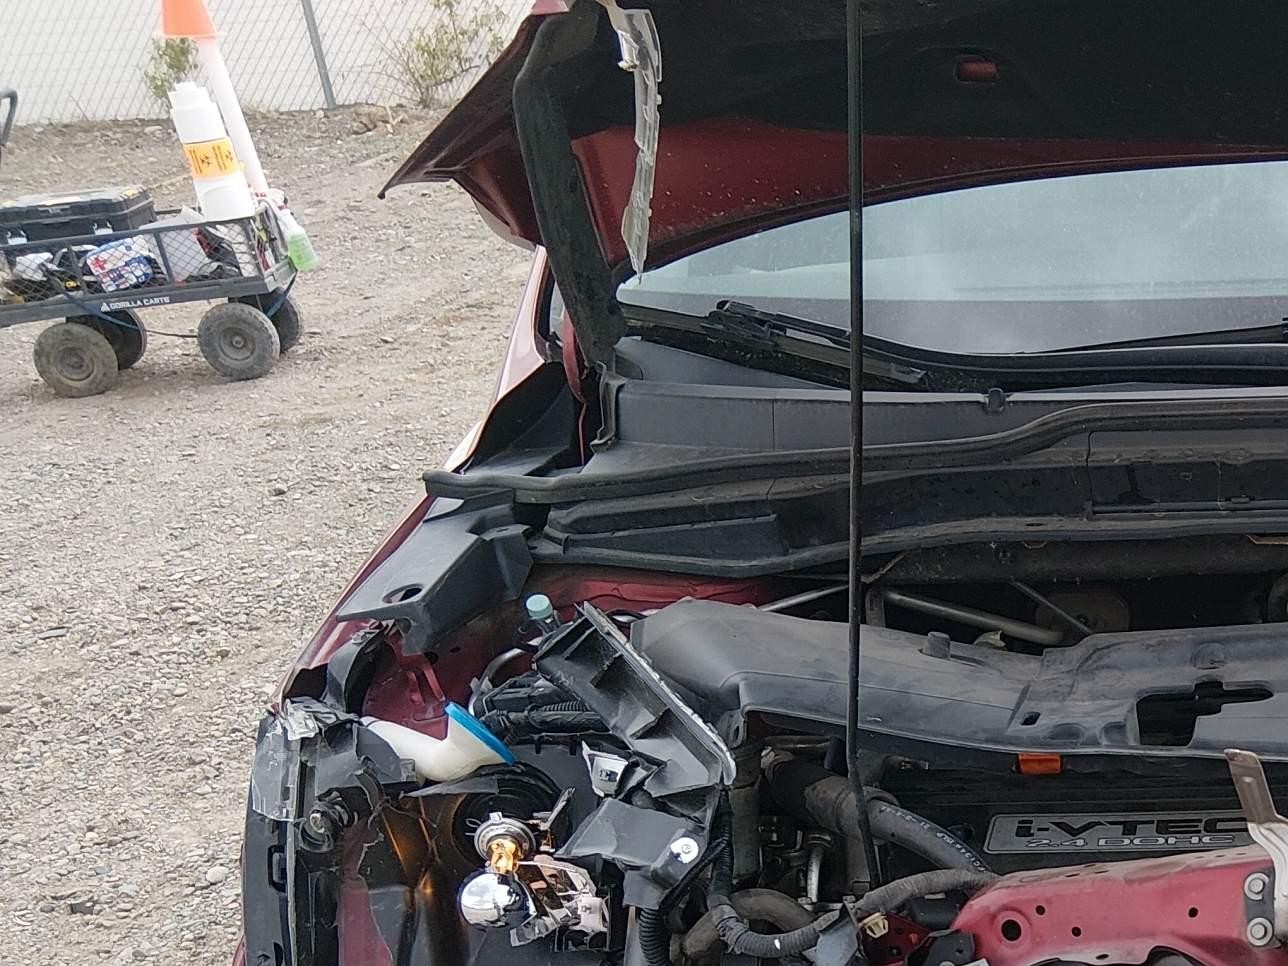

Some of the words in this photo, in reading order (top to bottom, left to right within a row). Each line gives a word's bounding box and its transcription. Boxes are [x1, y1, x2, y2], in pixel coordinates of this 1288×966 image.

[109, 299, 142, 310] GORILLA
[1014, 816, 1250, 838] i-VTEC
[1026, 837, 1089, 848] 2.4
[1097, 834, 1235, 847] DOHC
